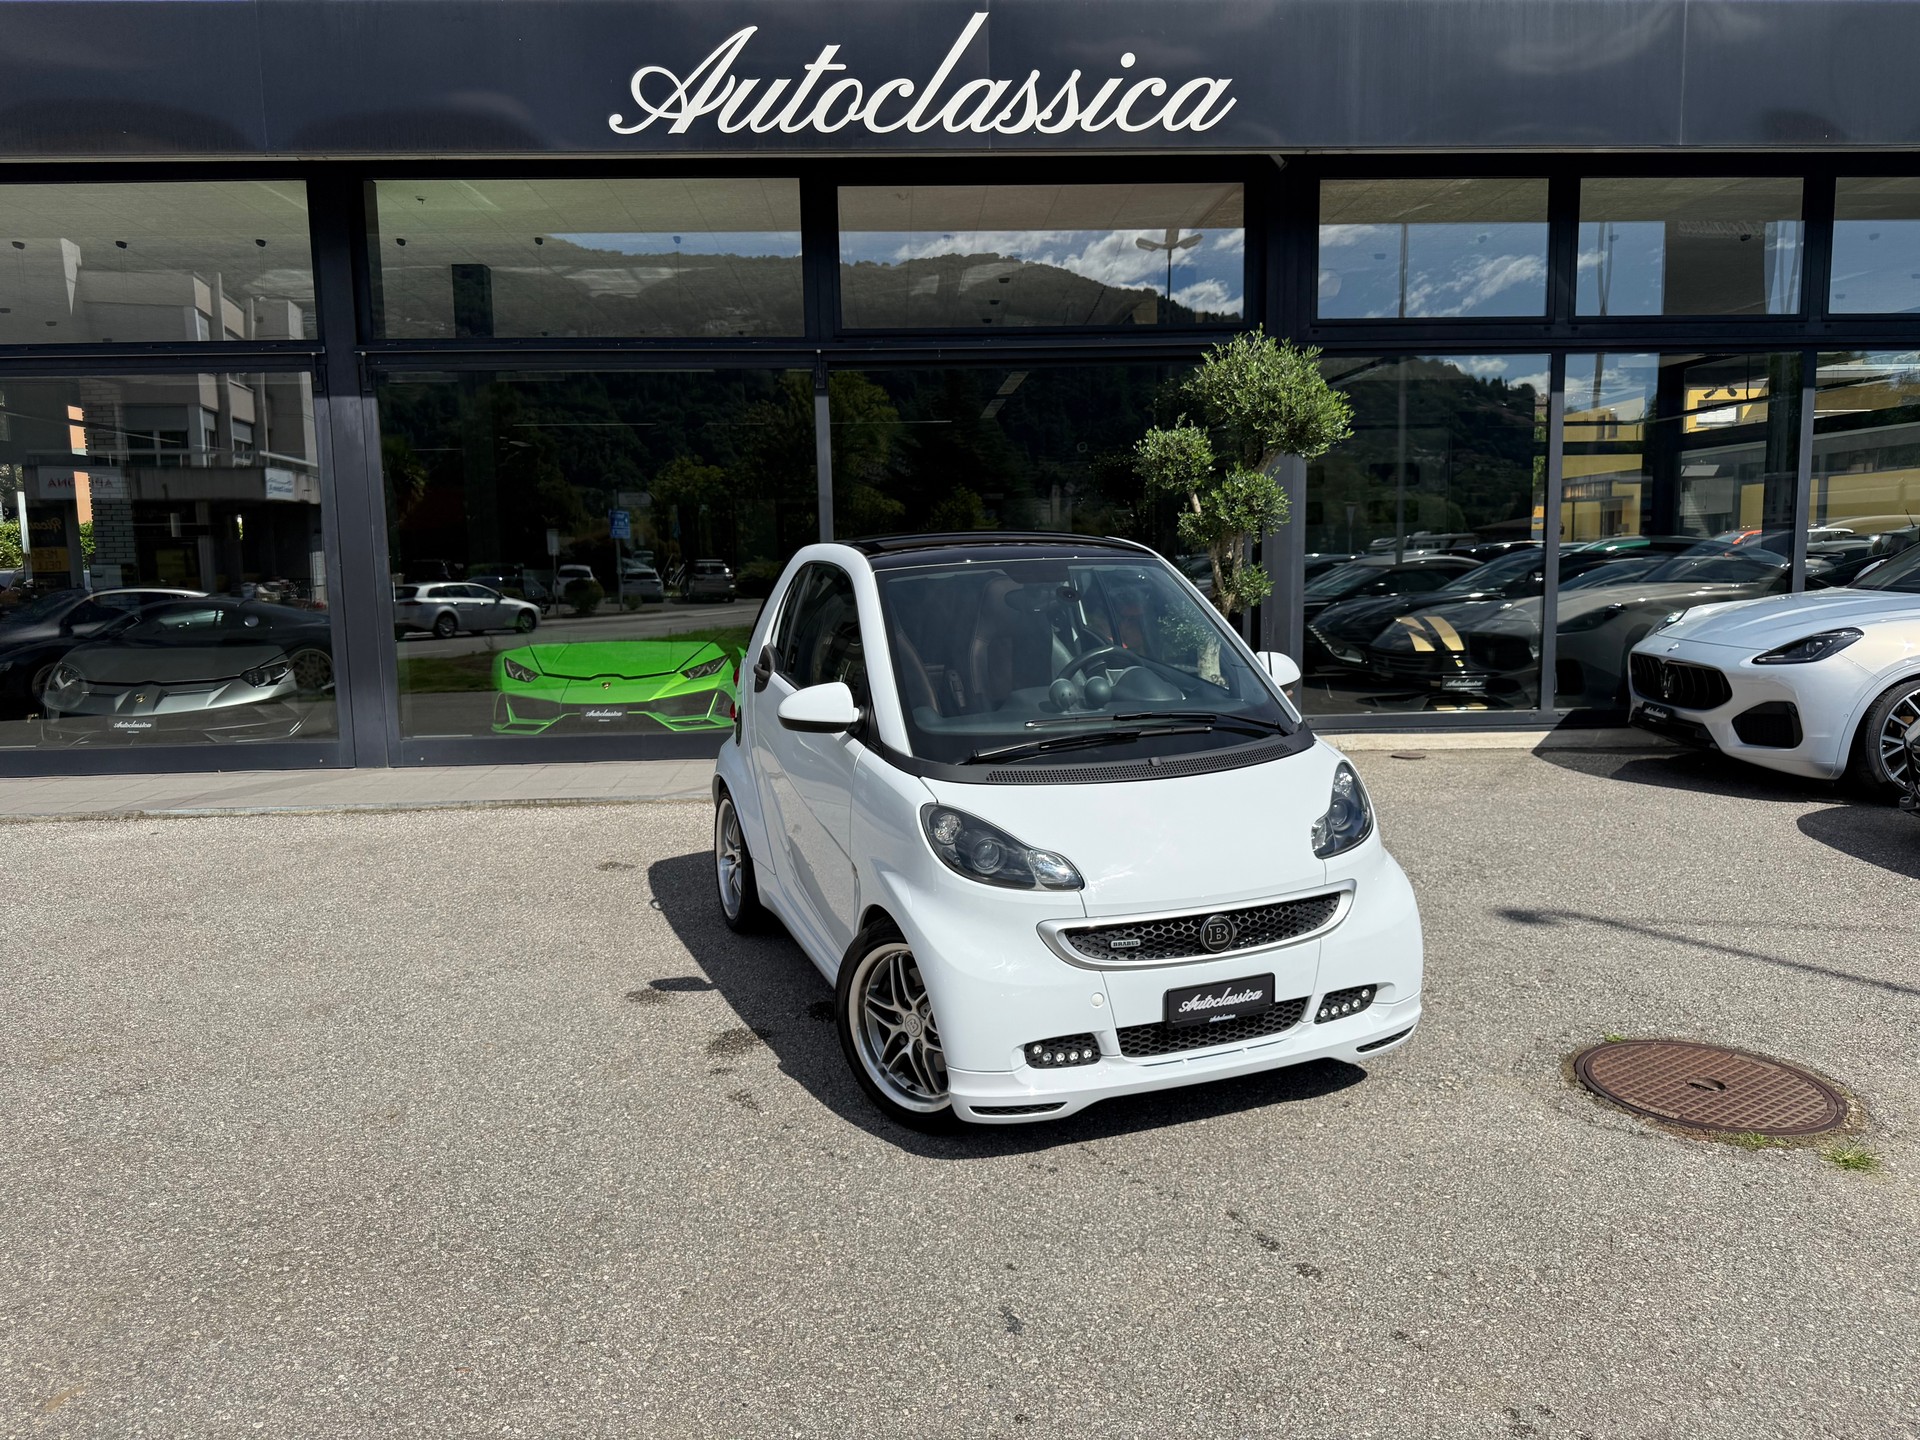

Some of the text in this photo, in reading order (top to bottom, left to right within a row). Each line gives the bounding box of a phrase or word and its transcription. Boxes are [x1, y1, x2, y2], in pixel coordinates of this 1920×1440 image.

[608, 11, 1237, 135] Autoclassica
[1112, 940, 1139, 948] BRABUS
[1208, 923, 1230, 945] B
[1178, 987, 1263, 1012] Autoclassica
